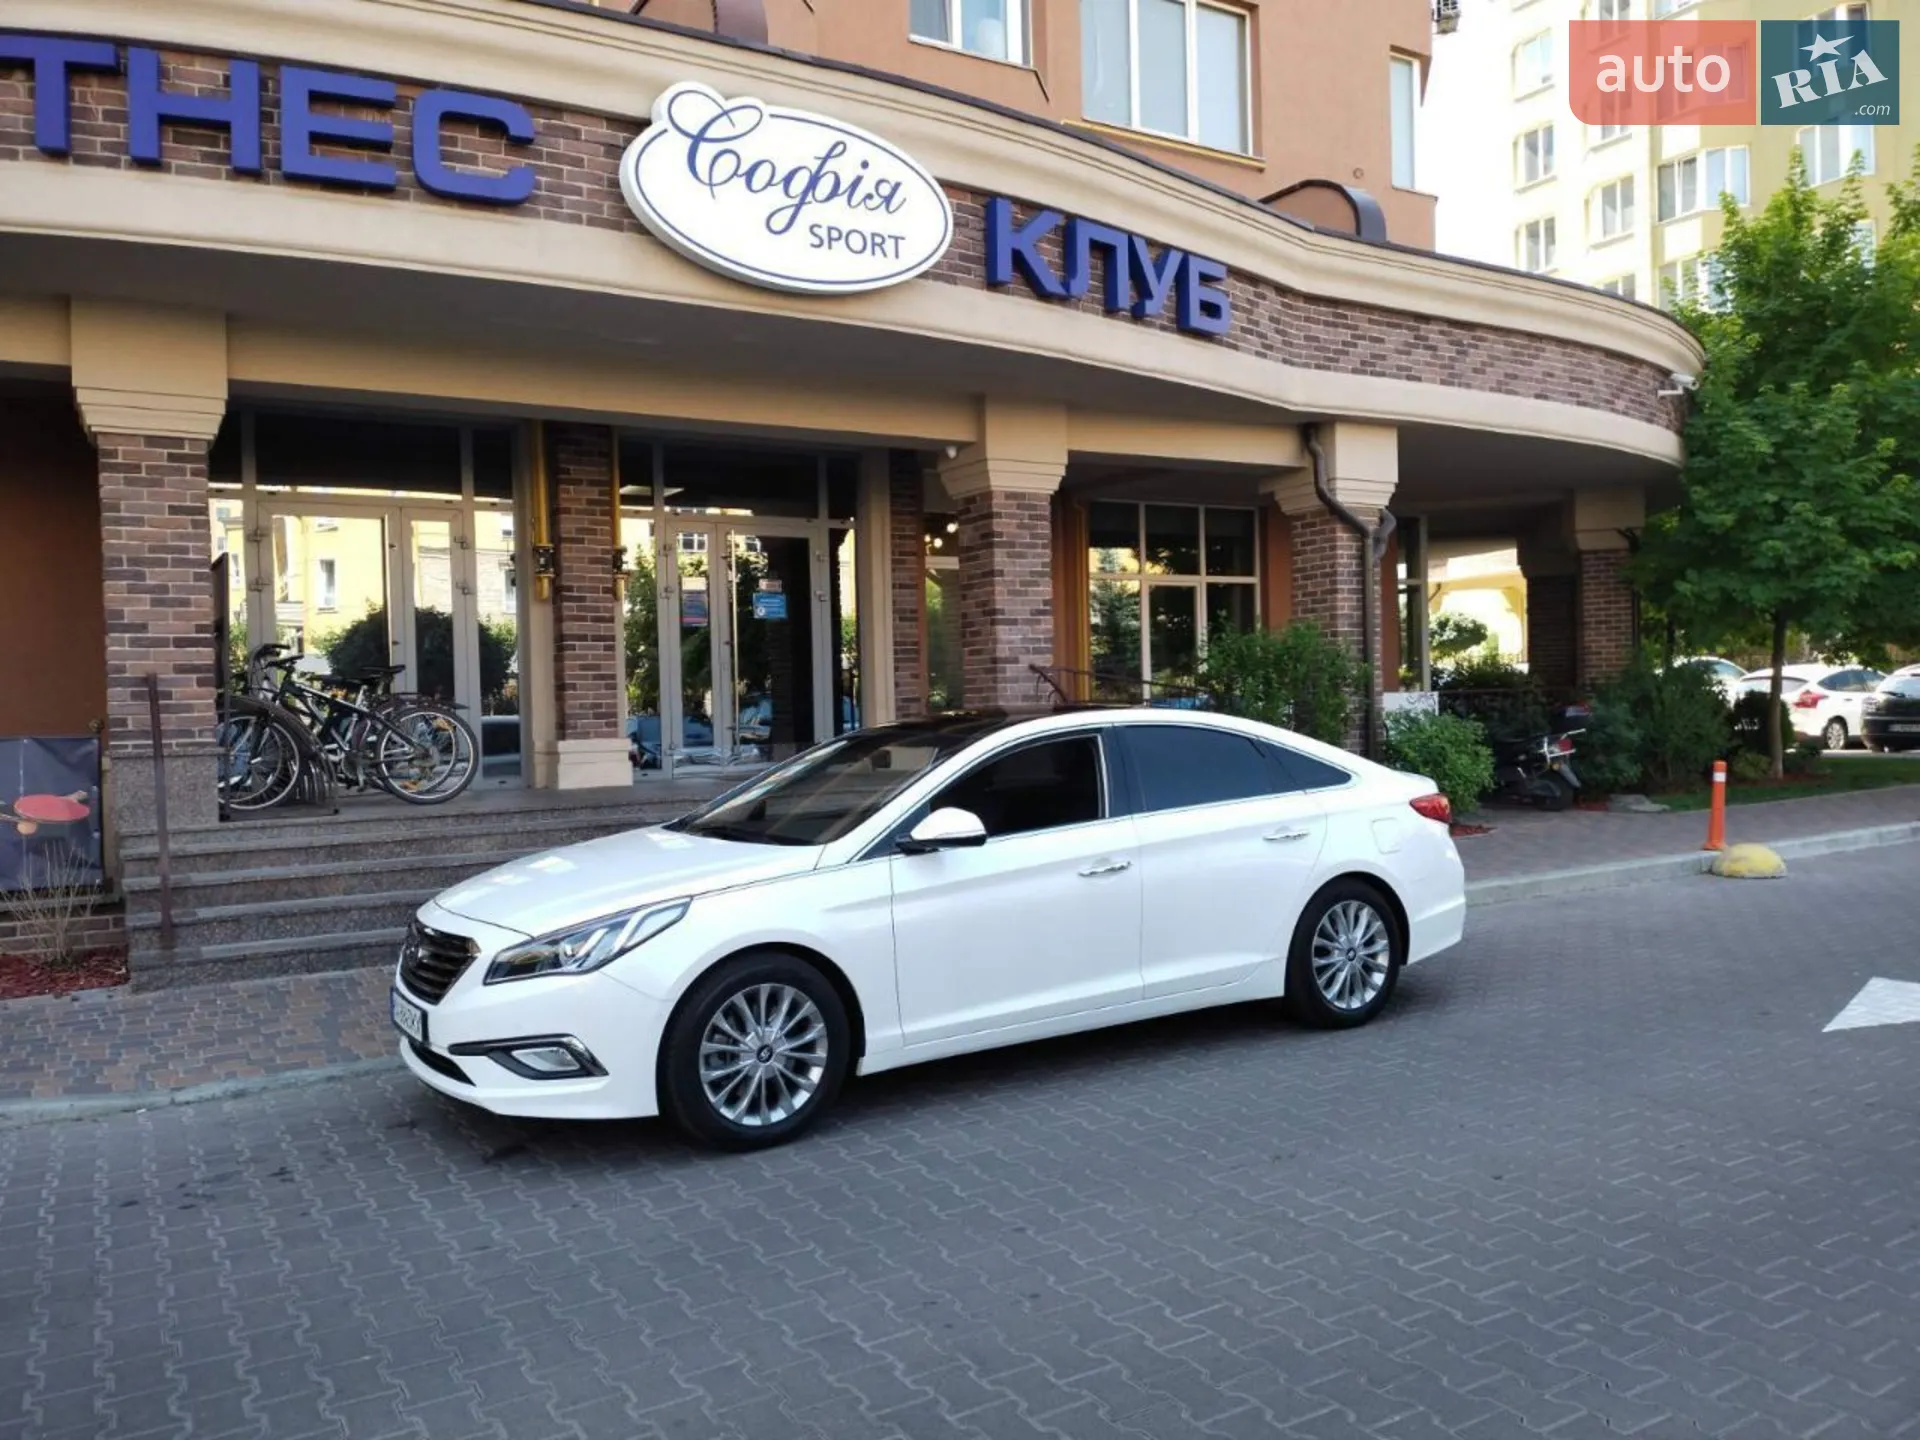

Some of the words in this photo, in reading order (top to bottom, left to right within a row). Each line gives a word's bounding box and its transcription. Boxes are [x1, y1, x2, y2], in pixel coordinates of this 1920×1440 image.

[0, 34, 535, 206] ТНЕС
[985, 197, 1232, 335] КЛУБ
[667, 89, 906, 235] Софія
[809, 224, 906, 259] SPORT
